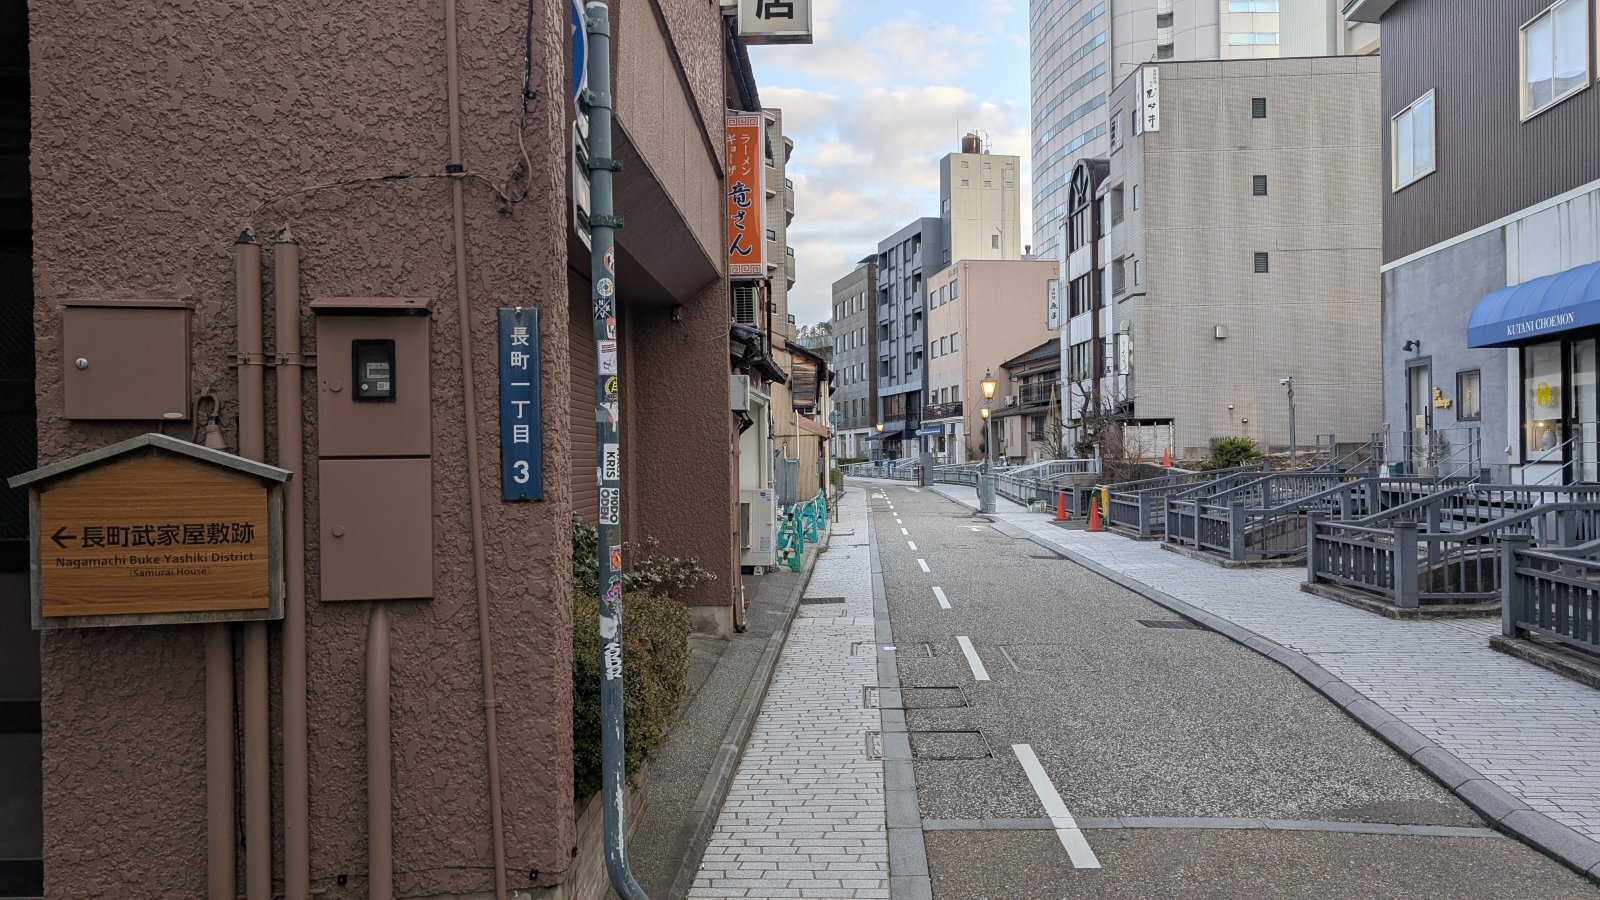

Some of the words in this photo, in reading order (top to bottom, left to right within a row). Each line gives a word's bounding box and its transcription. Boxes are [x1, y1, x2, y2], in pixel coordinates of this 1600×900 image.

[726, 134, 737, 176] ギョーザ
[741, 133, 751, 176] ラーメン
[728, 181, 752, 257] 竜さん
[1506, 320, 1534, 336] KUTANI
[1535, 311, 1574, 330] CHOEMON
[510, 327, 530, 443] 長町一丁目
[513, 460, 530, 483] 3
[606, 451, 616, 478] KRIS
[81, 522, 255, 548] 長町武家屋敷跡
[56, 555, 126, 569] Nagamachi
[129, 554, 161, 565] Buke
[164, 552, 208, 564] Yashiki
[211, 551, 255, 562] District
